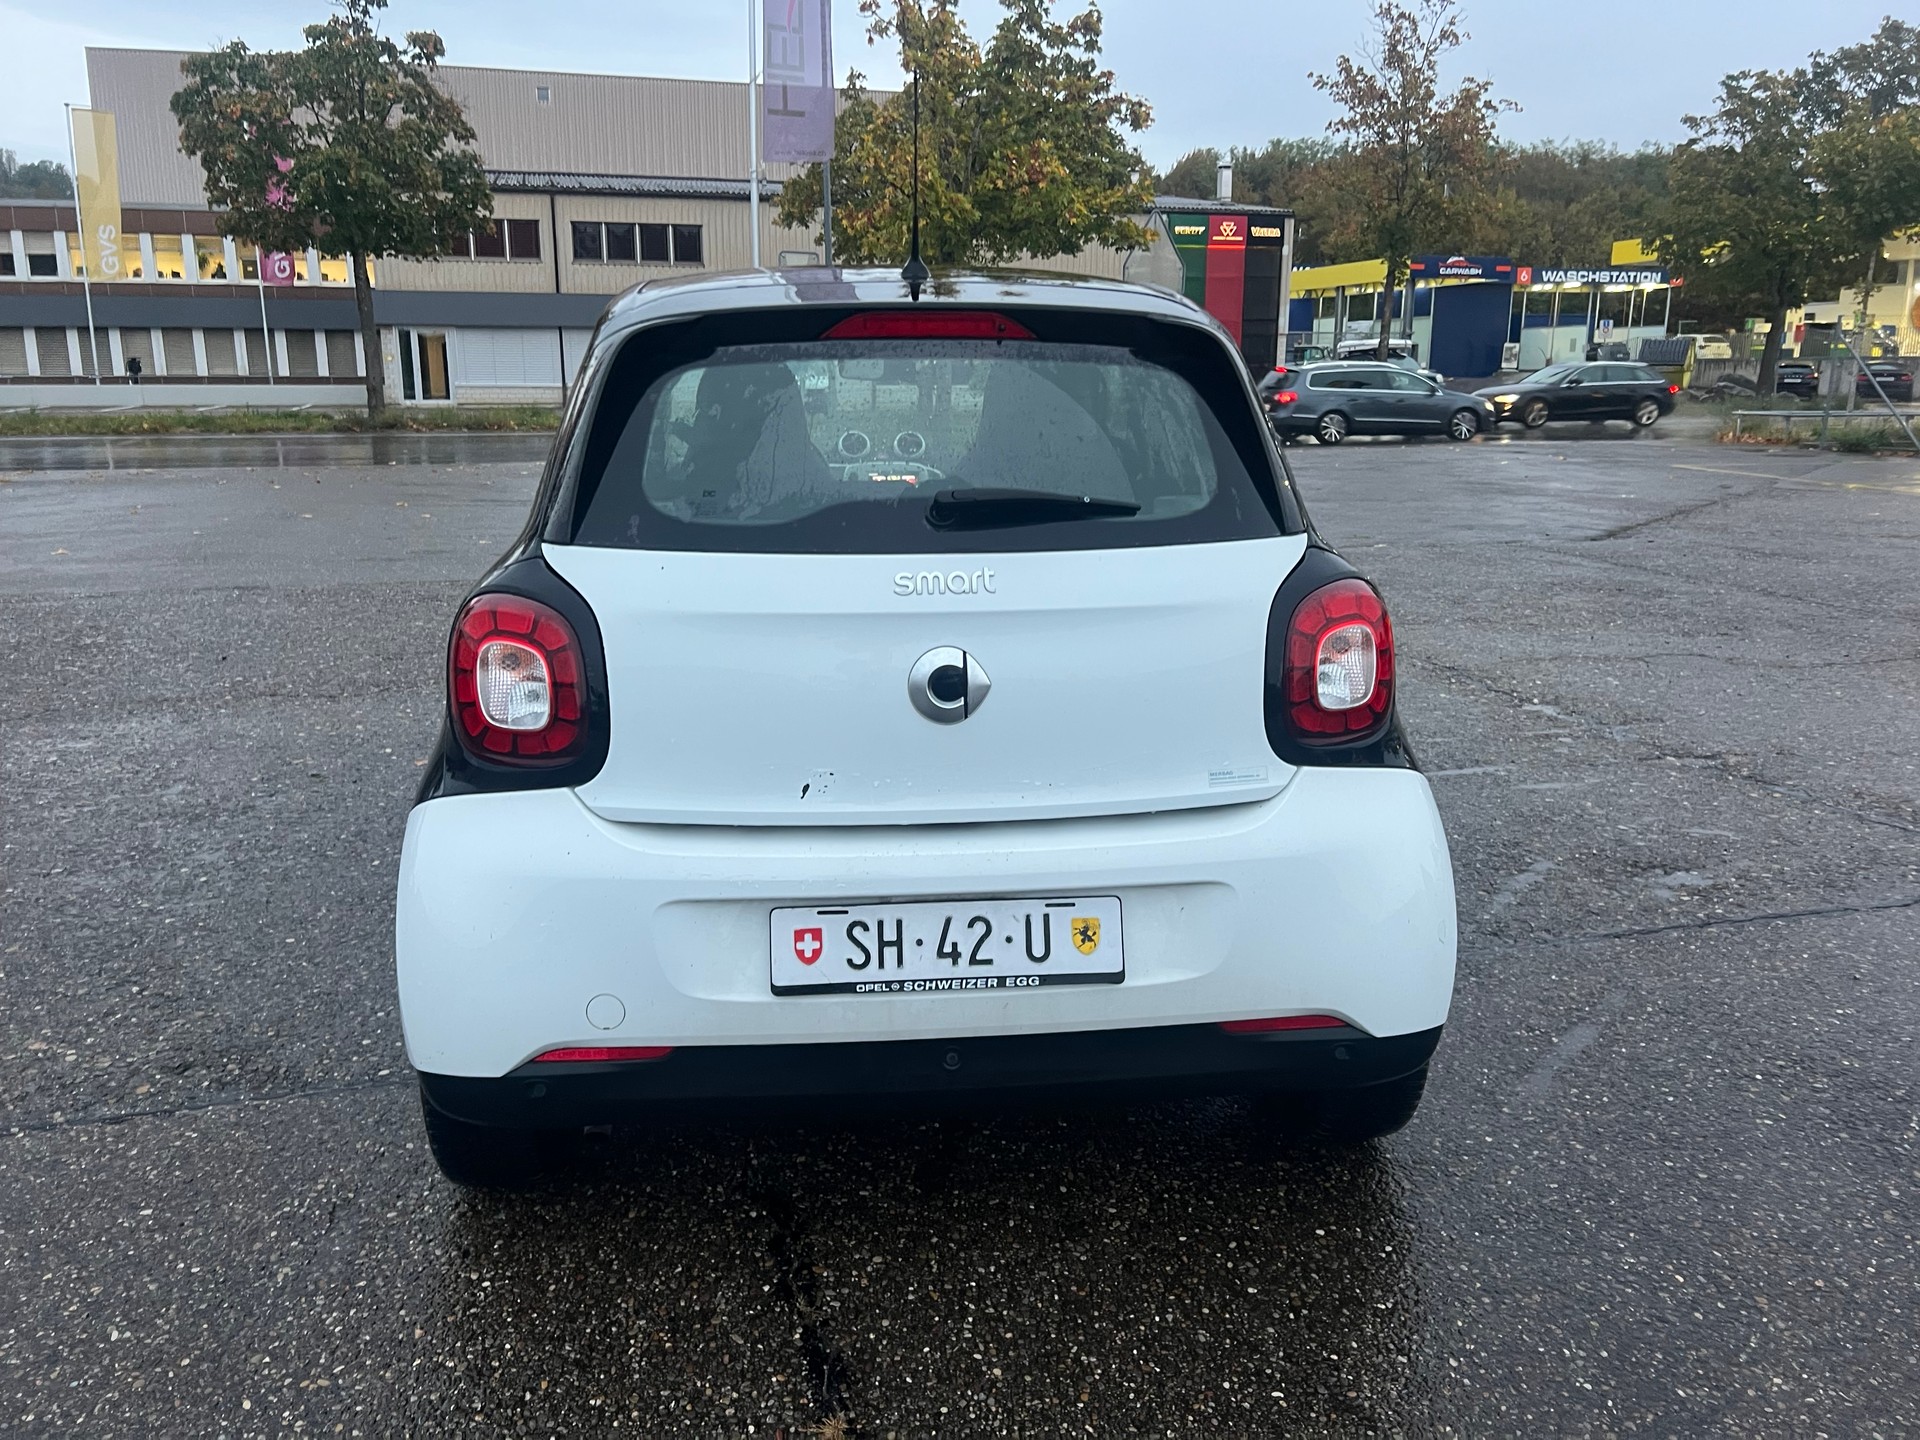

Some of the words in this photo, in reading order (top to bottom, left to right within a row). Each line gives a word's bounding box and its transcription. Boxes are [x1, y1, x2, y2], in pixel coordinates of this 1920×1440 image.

[99, 224, 119, 274] GVS
[1439, 267, 1482, 276] CARWASH
[1520, 270, 1528, 281] 6
[1541, 270, 1662, 284] WASCHSTATION
[893, 566, 996, 596] smart
[855, 983, 890, 993] OPEL
[903, 978, 998, 992] SCHWEIZER
[1005, 976, 1041, 988] EGG
